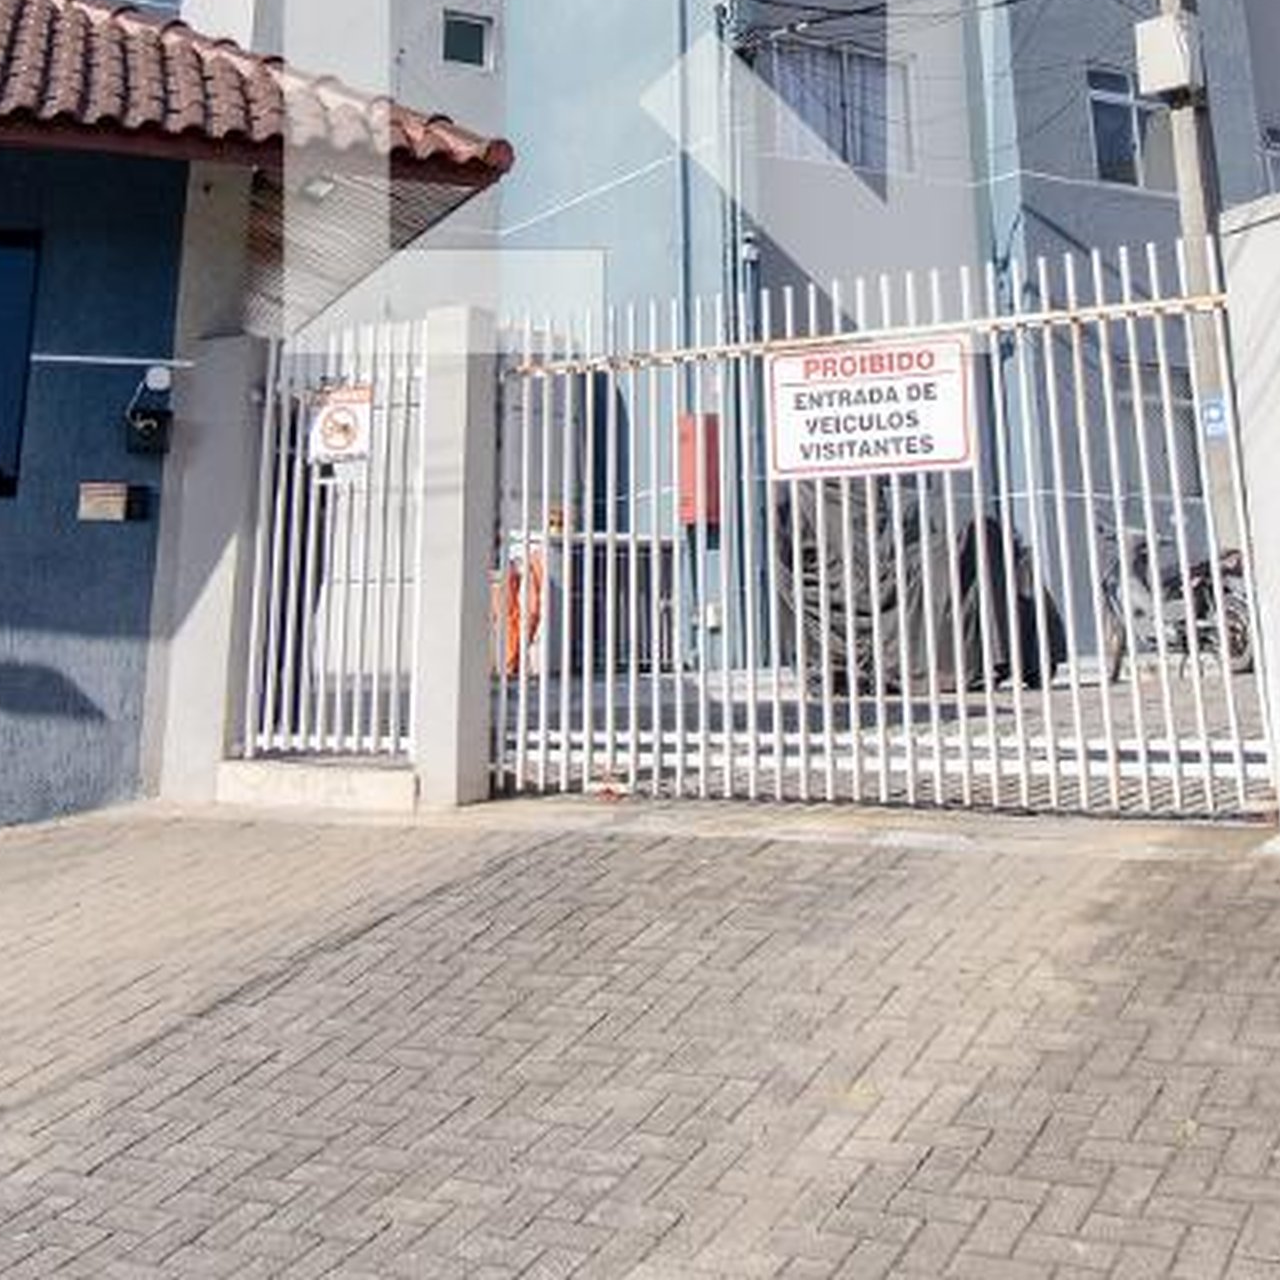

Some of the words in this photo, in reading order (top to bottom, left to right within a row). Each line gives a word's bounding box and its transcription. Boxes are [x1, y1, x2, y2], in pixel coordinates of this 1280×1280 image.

[803, 351, 935, 379] PROIBIDO
[793, 386, 899, 411] ENTRADA
[906, 383, 938, 401] DE
[799, 434, 935, 460] VISITANTES
